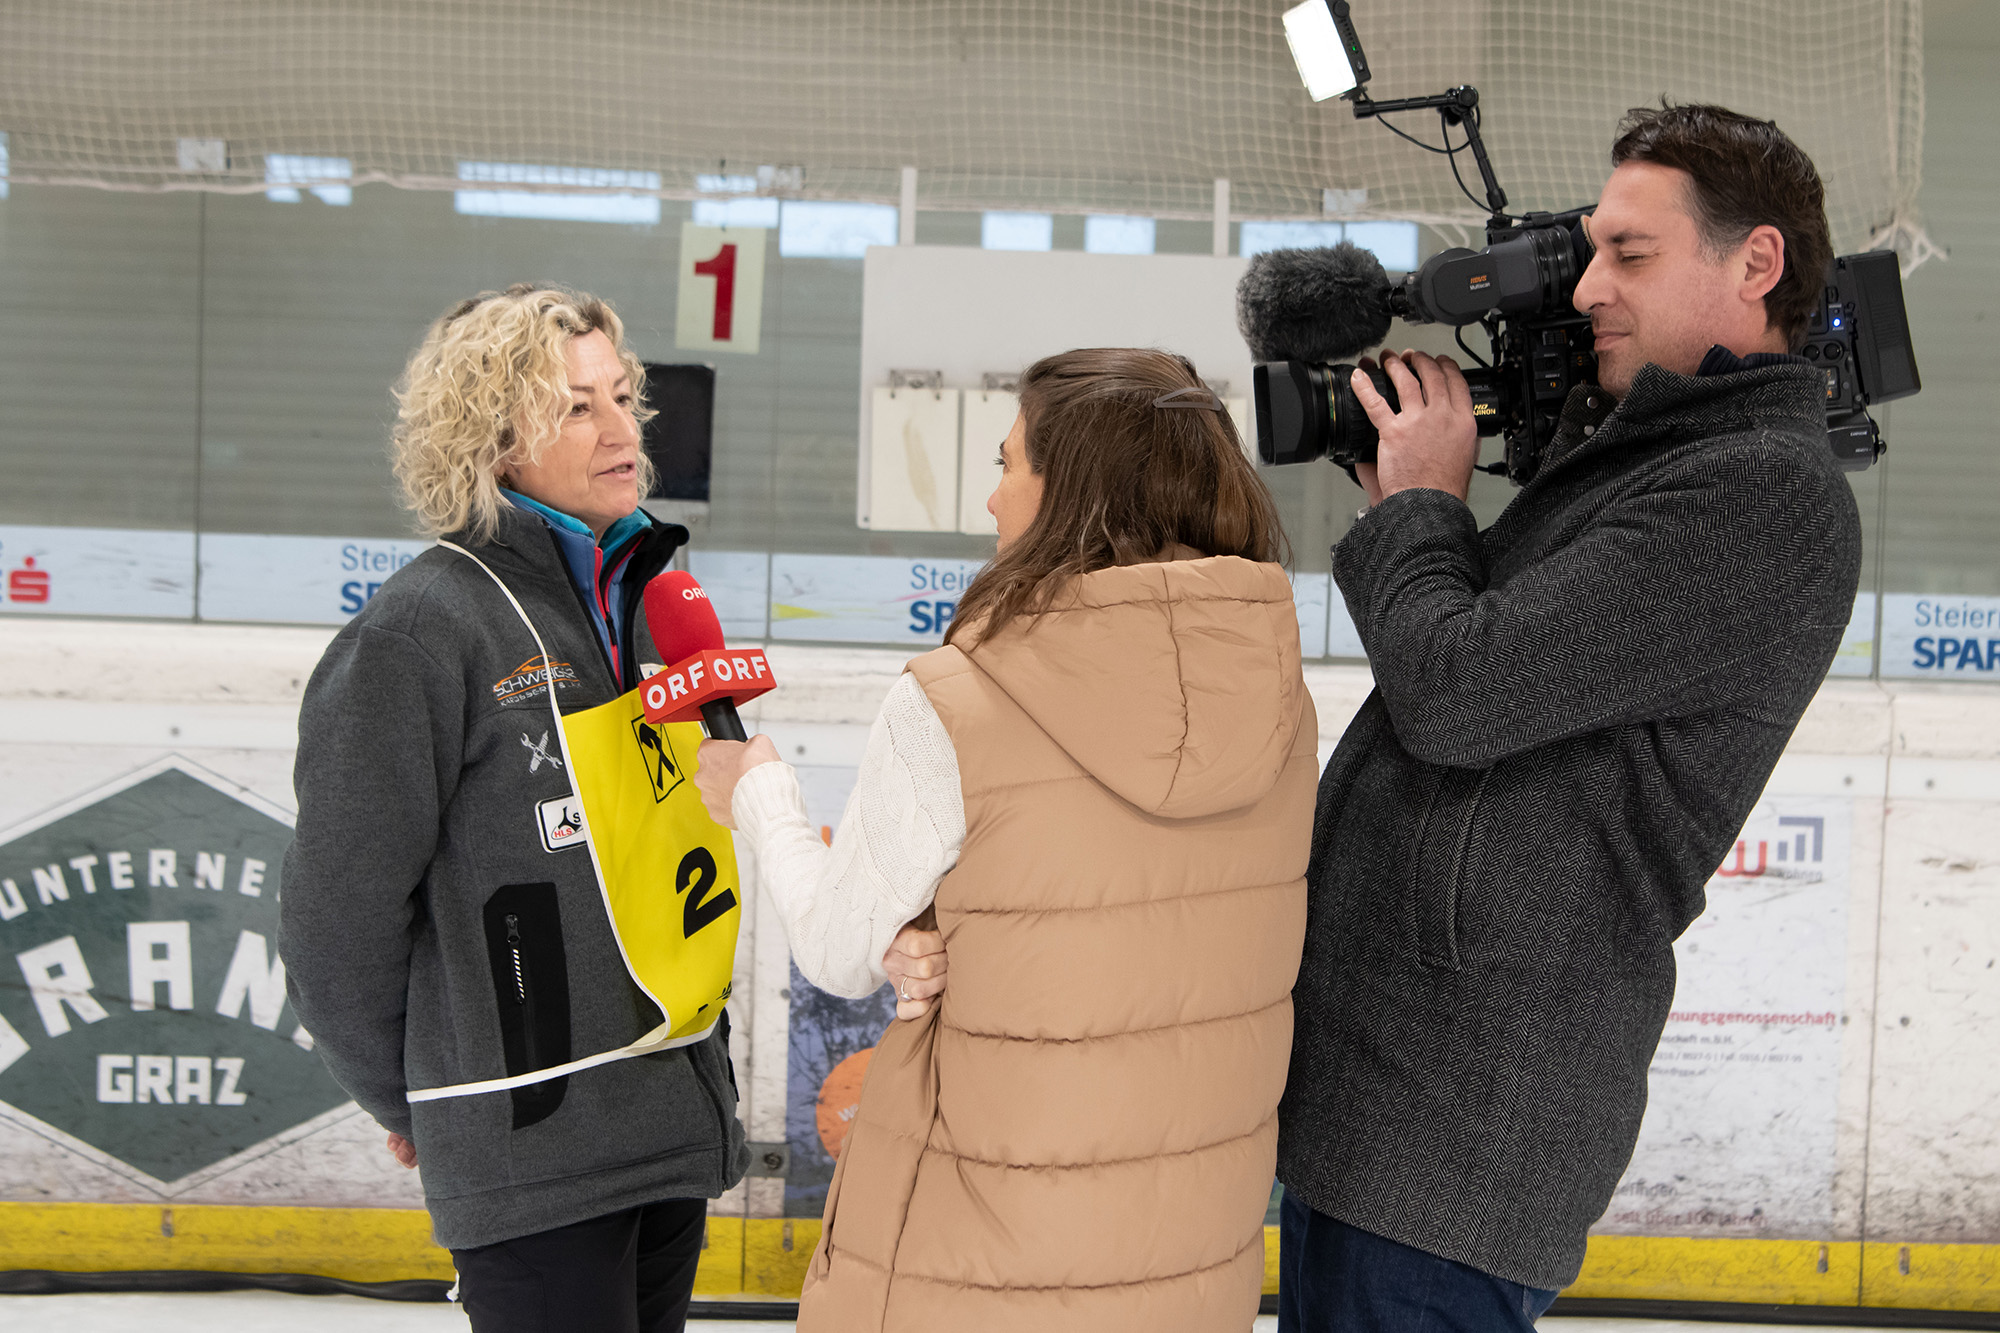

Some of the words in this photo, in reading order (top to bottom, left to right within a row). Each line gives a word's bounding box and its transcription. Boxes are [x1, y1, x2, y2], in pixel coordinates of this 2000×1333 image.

[694, 243, 738, 342] 1
[1915, 600, 2000, 629] Steier
[646, 660, 706, 710] ORF
[713, 656, 767, 682] ORF
[554, 827, 573, 838] HLS
[0, 849, 281, 921] UNTERNE
[675, 846, 738, 940] 2
[1668, 1010, 1836, 1026] nungsgenossenschaft
[97, 1055, 248, 1105] GRAZ
